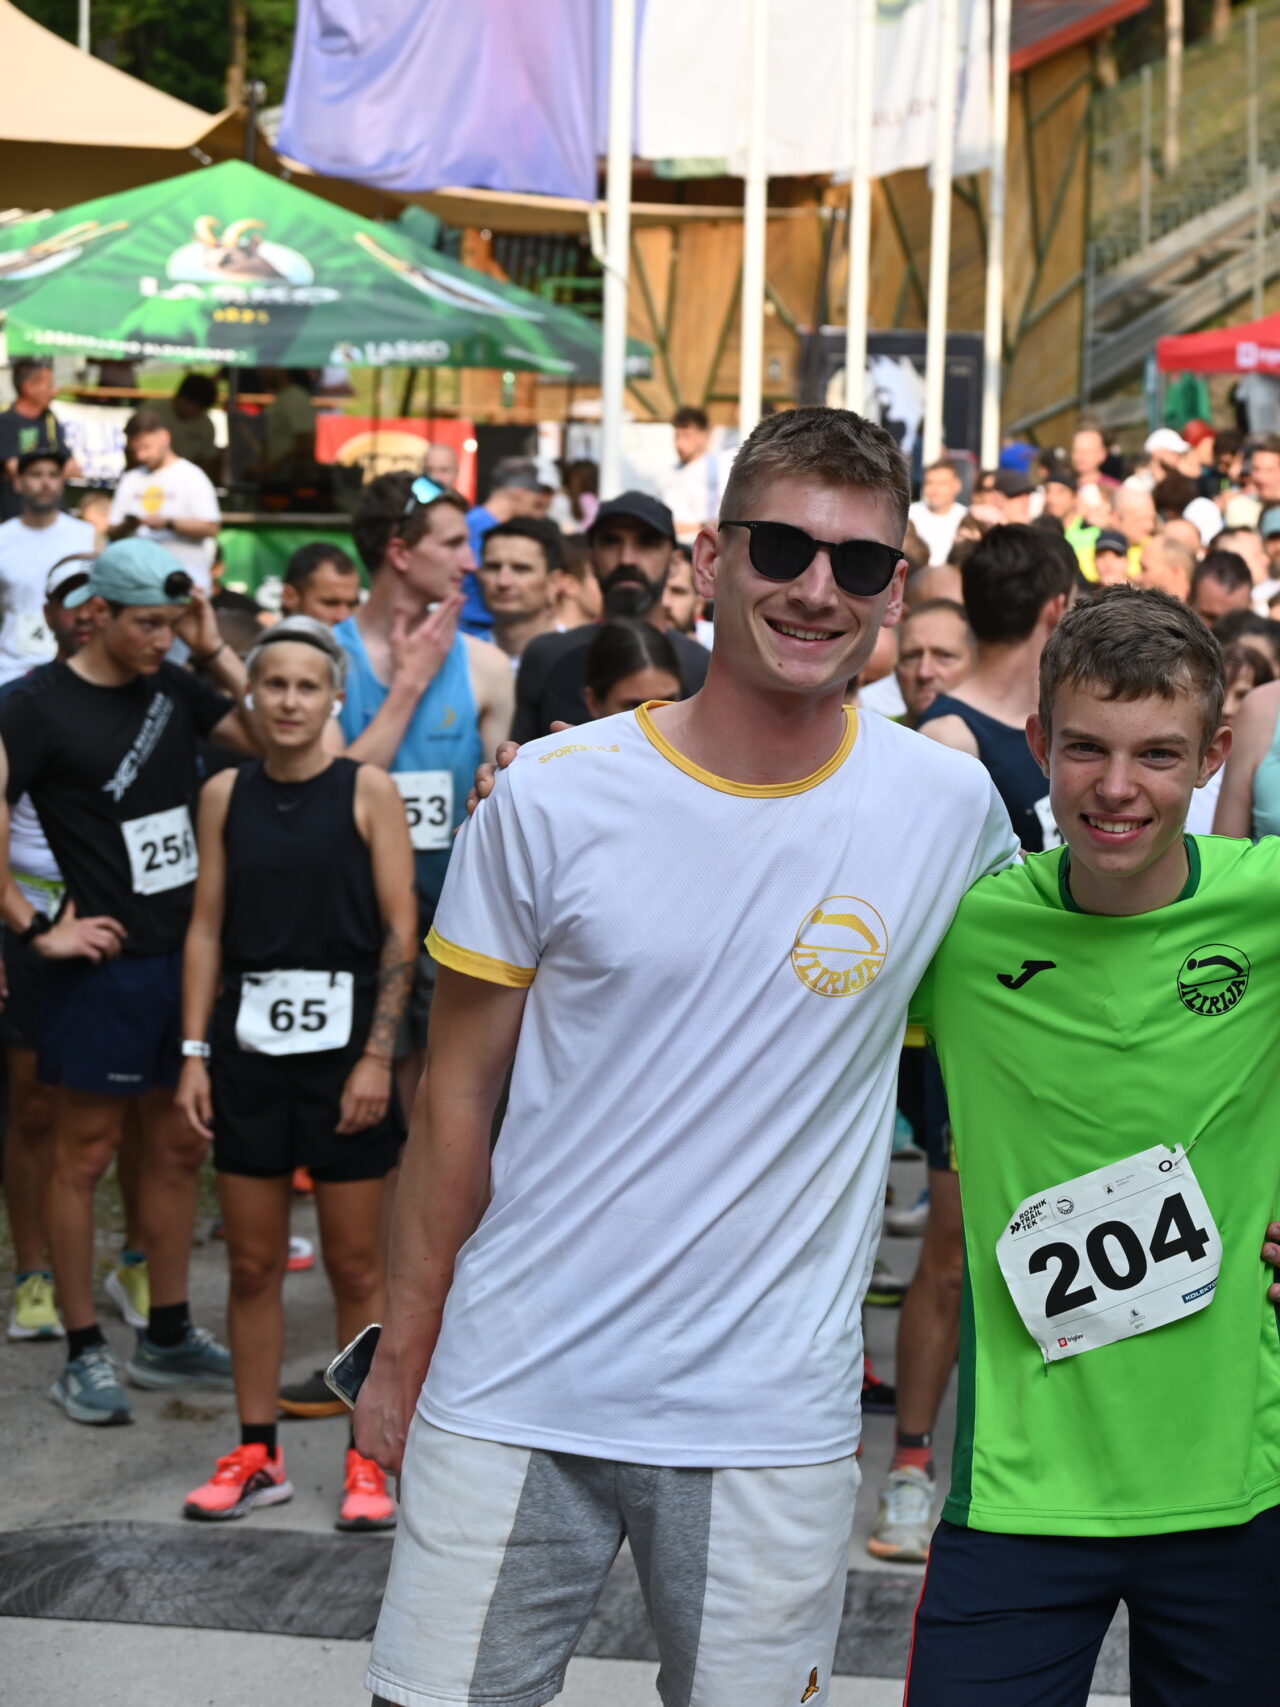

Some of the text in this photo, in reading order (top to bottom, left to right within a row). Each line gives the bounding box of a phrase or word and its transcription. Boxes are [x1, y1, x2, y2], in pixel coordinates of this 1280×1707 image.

[269, 998, 328, 1033] 65
[1020, 1210, 1043, 1226] TRAIL
[1022, 1219, 1038, 1231] TEK
[1028, 1192, 1210, 1319] 204
[1185, 1280, 1217, 1301] KOLEKTO
